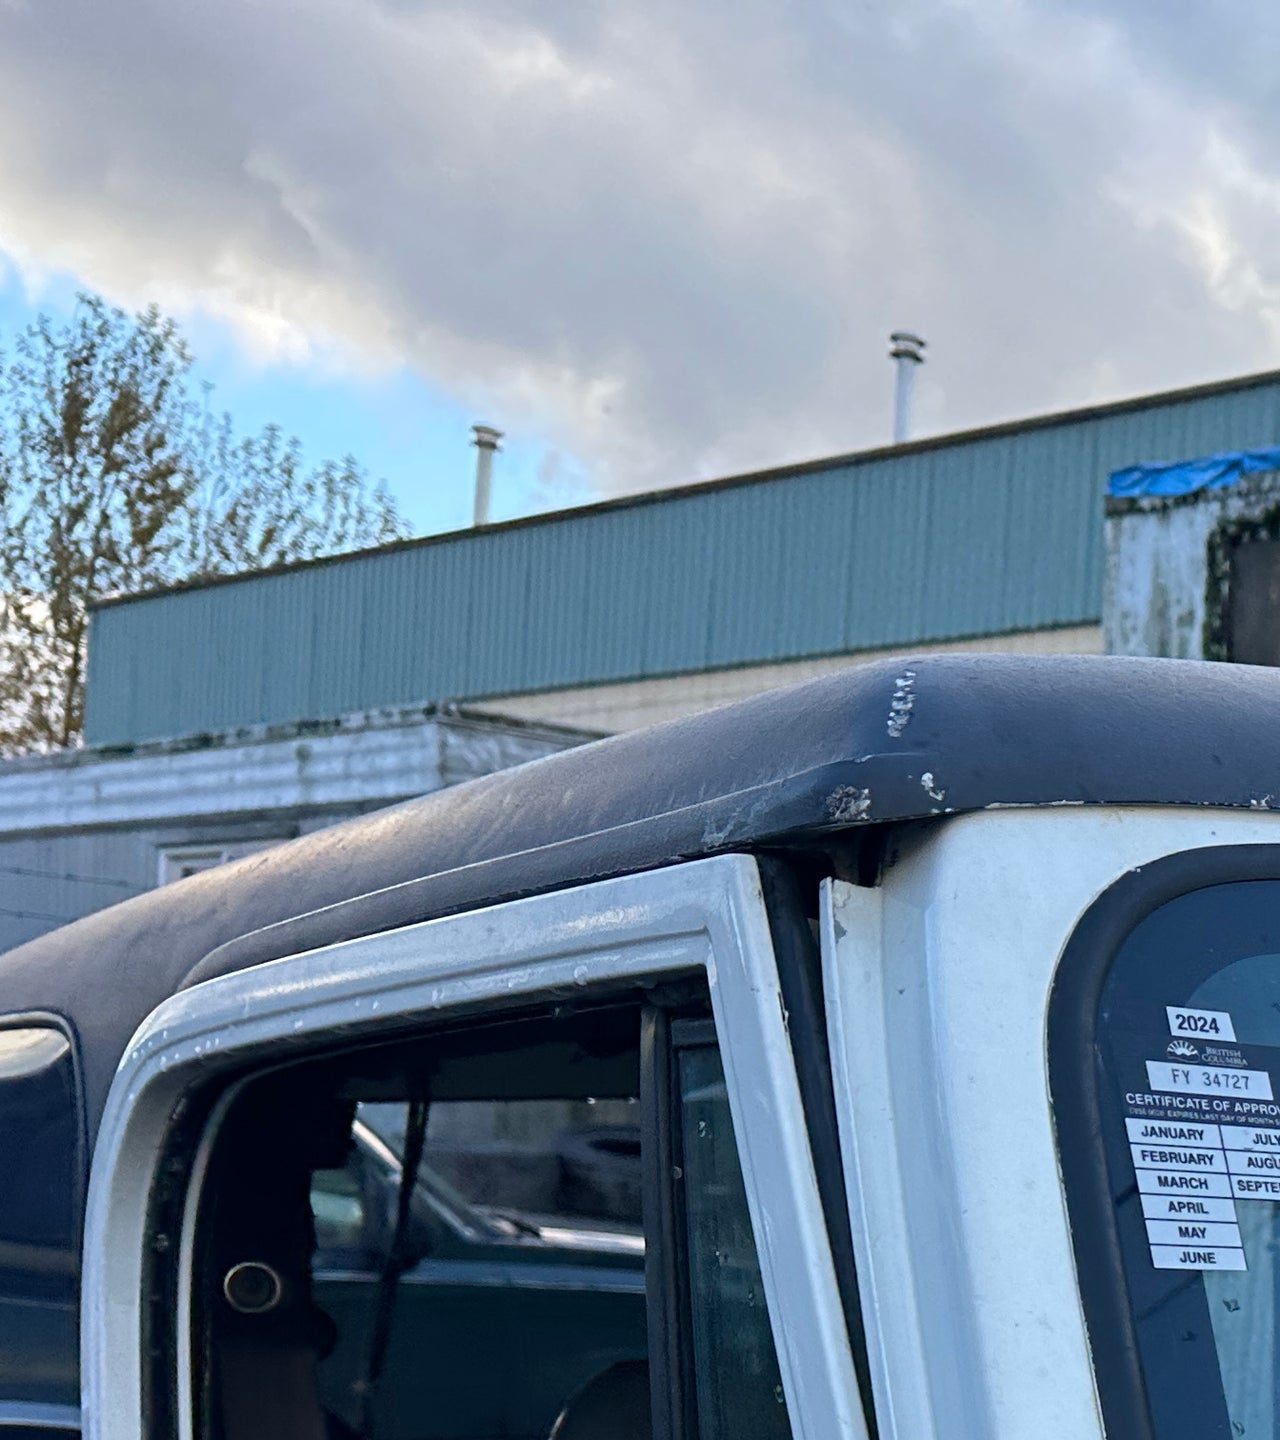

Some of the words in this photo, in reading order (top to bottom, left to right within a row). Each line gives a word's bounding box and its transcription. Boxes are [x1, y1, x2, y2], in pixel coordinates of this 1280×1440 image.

[1175, 1014, 1220, 1034] 2024
[1171, 1068, 1190, 1085] FY
[1202, 1071, 1250, 1090] 34727
[1125, 1092, 1211, 1111] CERTIFICATE
[1213, 1100, 1230, 1111] OF
[1141, 1125, 1204, 1141] JANUARY
[1141, 1150, 1214, 1166] FEBRUARY
[1157, 1175, 1208, 1190] MARCH
[1168, 1201, 1209, 1215] APRIL
[1178, 1226, 1206, 1239] MAY
[1179, 1251, 1216, 1264] JUNE
